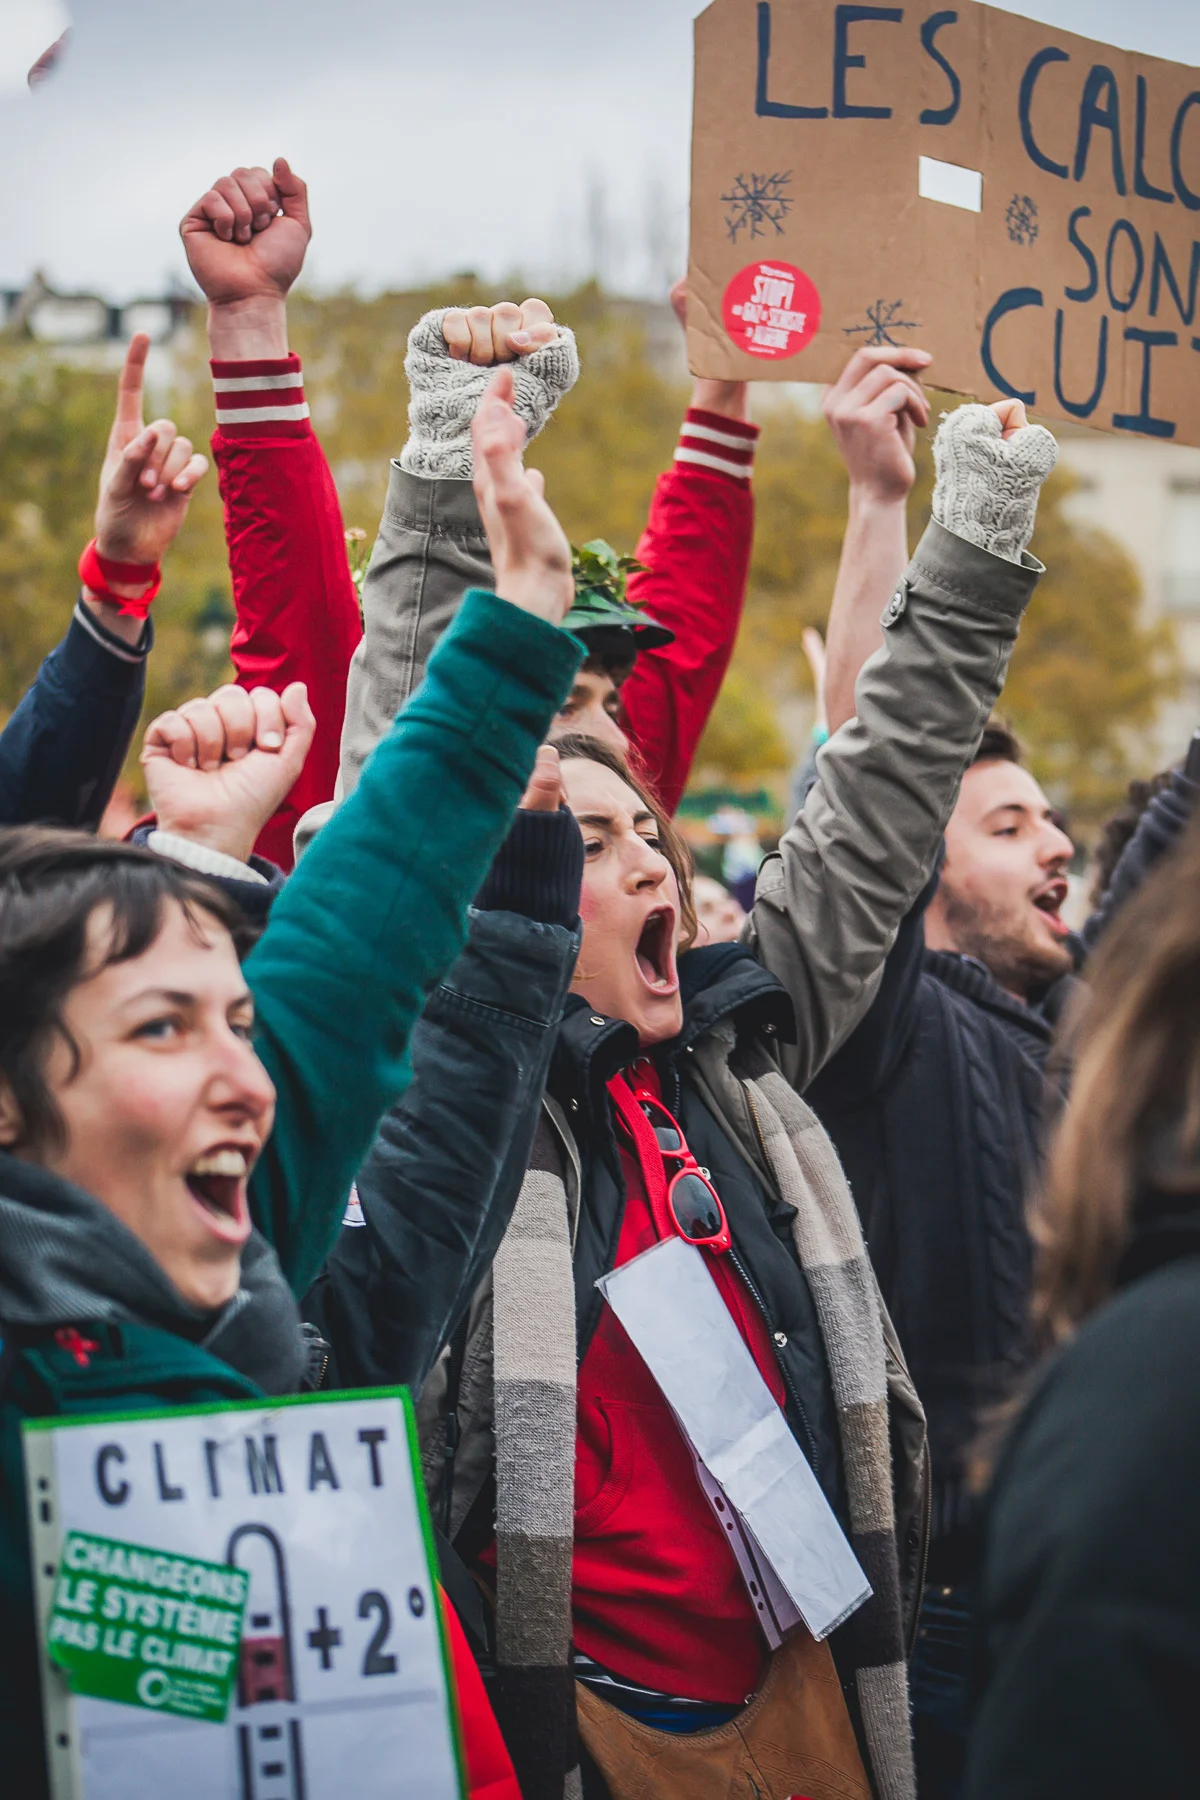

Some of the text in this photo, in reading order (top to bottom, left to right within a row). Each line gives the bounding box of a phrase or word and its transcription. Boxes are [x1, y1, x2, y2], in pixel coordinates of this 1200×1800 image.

[756, 1, 962, 125] LES
[980, 286, 1200, 438] CUI
[96, 1429, 387, 1507] CLIMAT
[58, 1577, 97, 1613] LE
[65, 1538, 246, 1604] CHANGEONS
[51, 1615, 235, 1676] PAS LE CLIMAT
